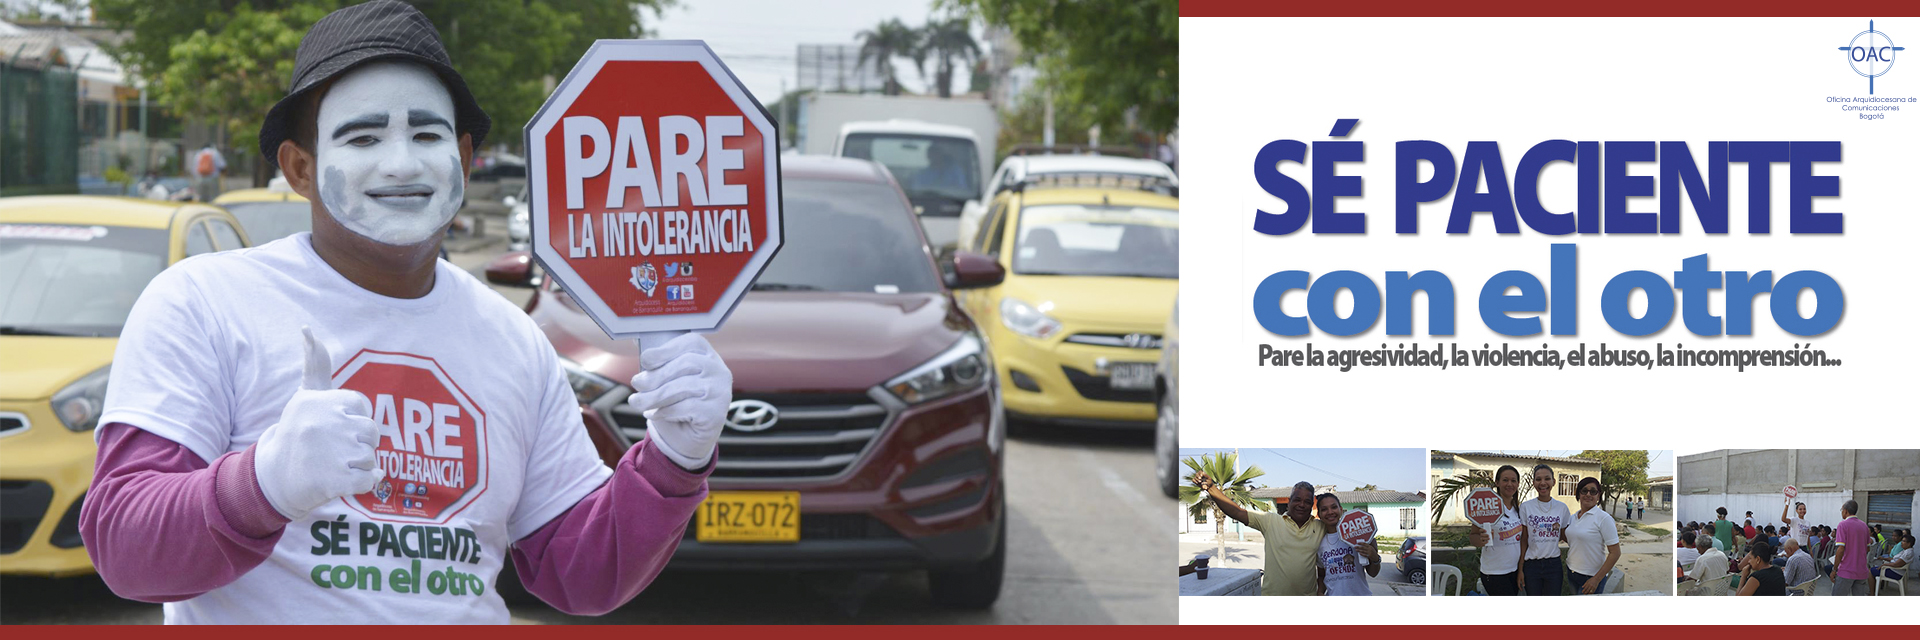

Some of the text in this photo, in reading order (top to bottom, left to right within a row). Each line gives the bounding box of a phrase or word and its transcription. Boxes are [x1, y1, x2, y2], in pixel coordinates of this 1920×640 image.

[563, 115, 748, 209] PARE
[568, 209, 753, 258] LA INTOLERANCIA
[1342, 515, 1371, 534] PARE
[1471, 497, 1499, 510] PARE
[311, 514, 482, 564] SÉ PACIENTE
[311, 559, 485, 596] con el otro
